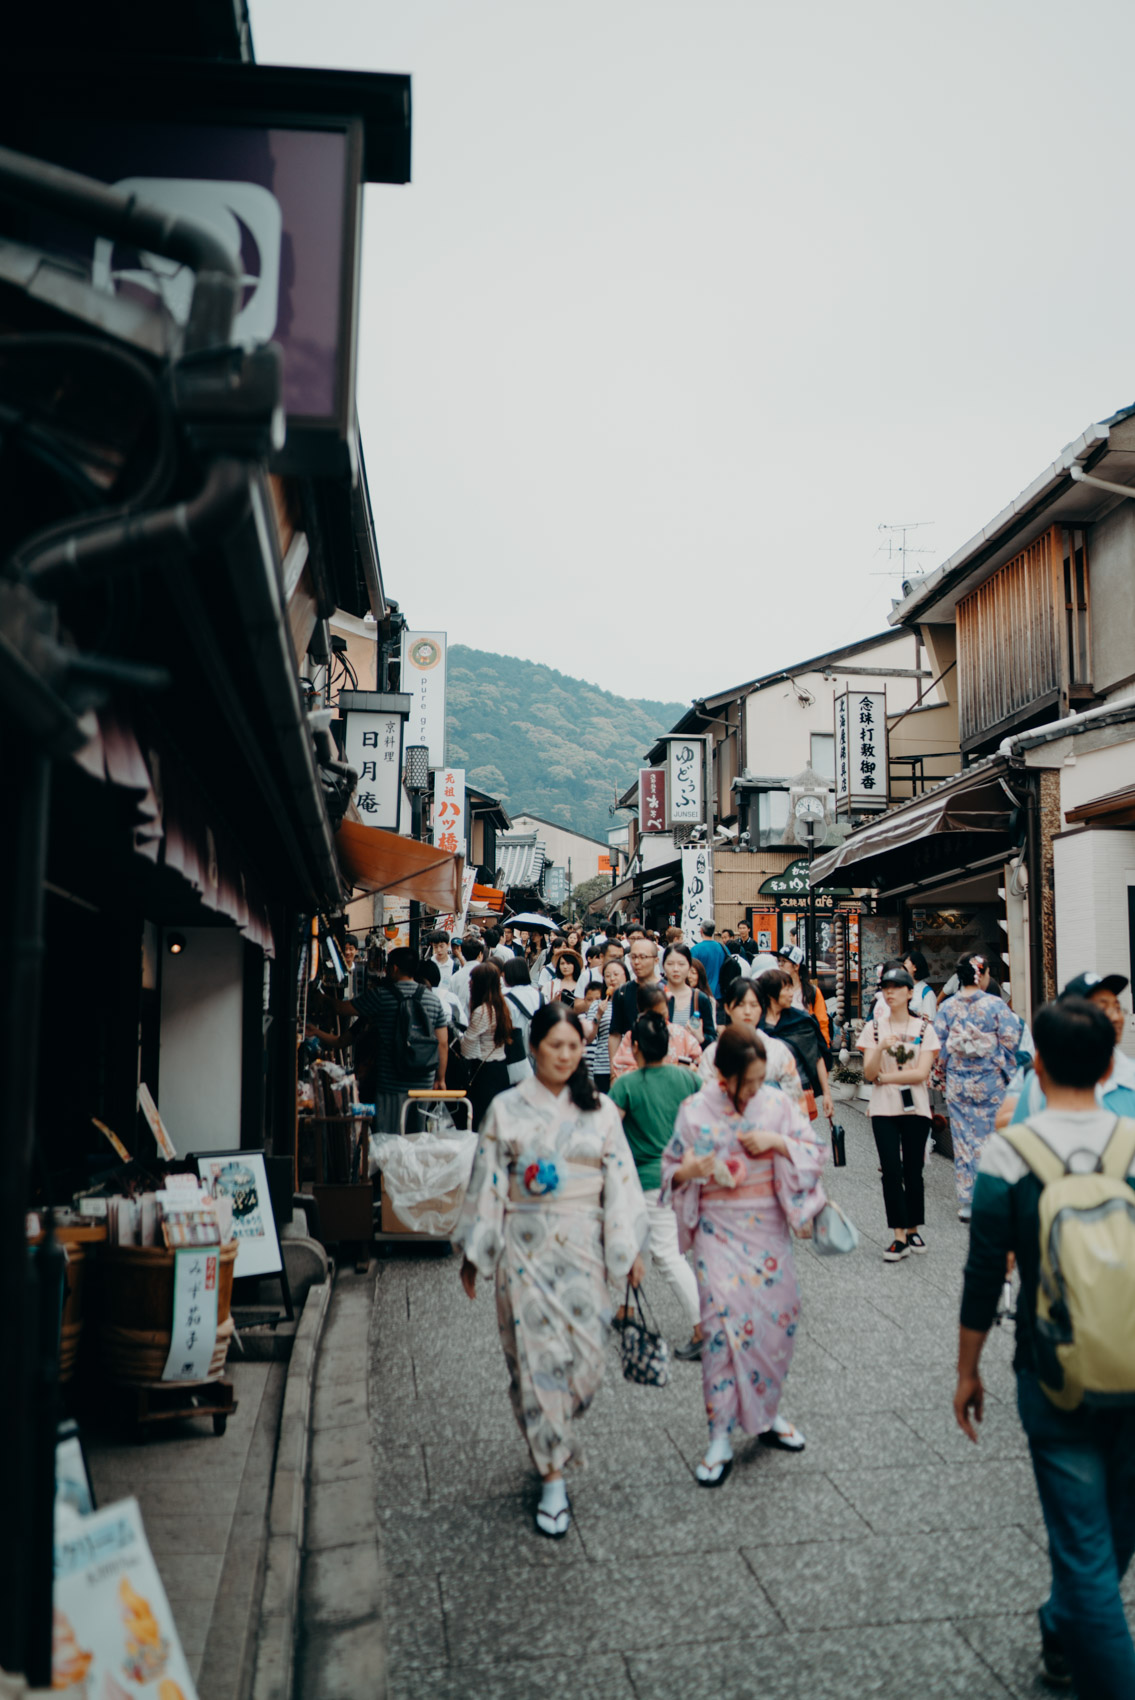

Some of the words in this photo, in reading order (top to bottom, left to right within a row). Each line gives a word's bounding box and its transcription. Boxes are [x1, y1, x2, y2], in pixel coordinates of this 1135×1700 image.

[384, 720, 396, 763] 京料理
[357, 731, 381, 814] 日月庵
[444, 773, 456, 797] 元祖
[676, 746, 697, 808] ゆどうふ
